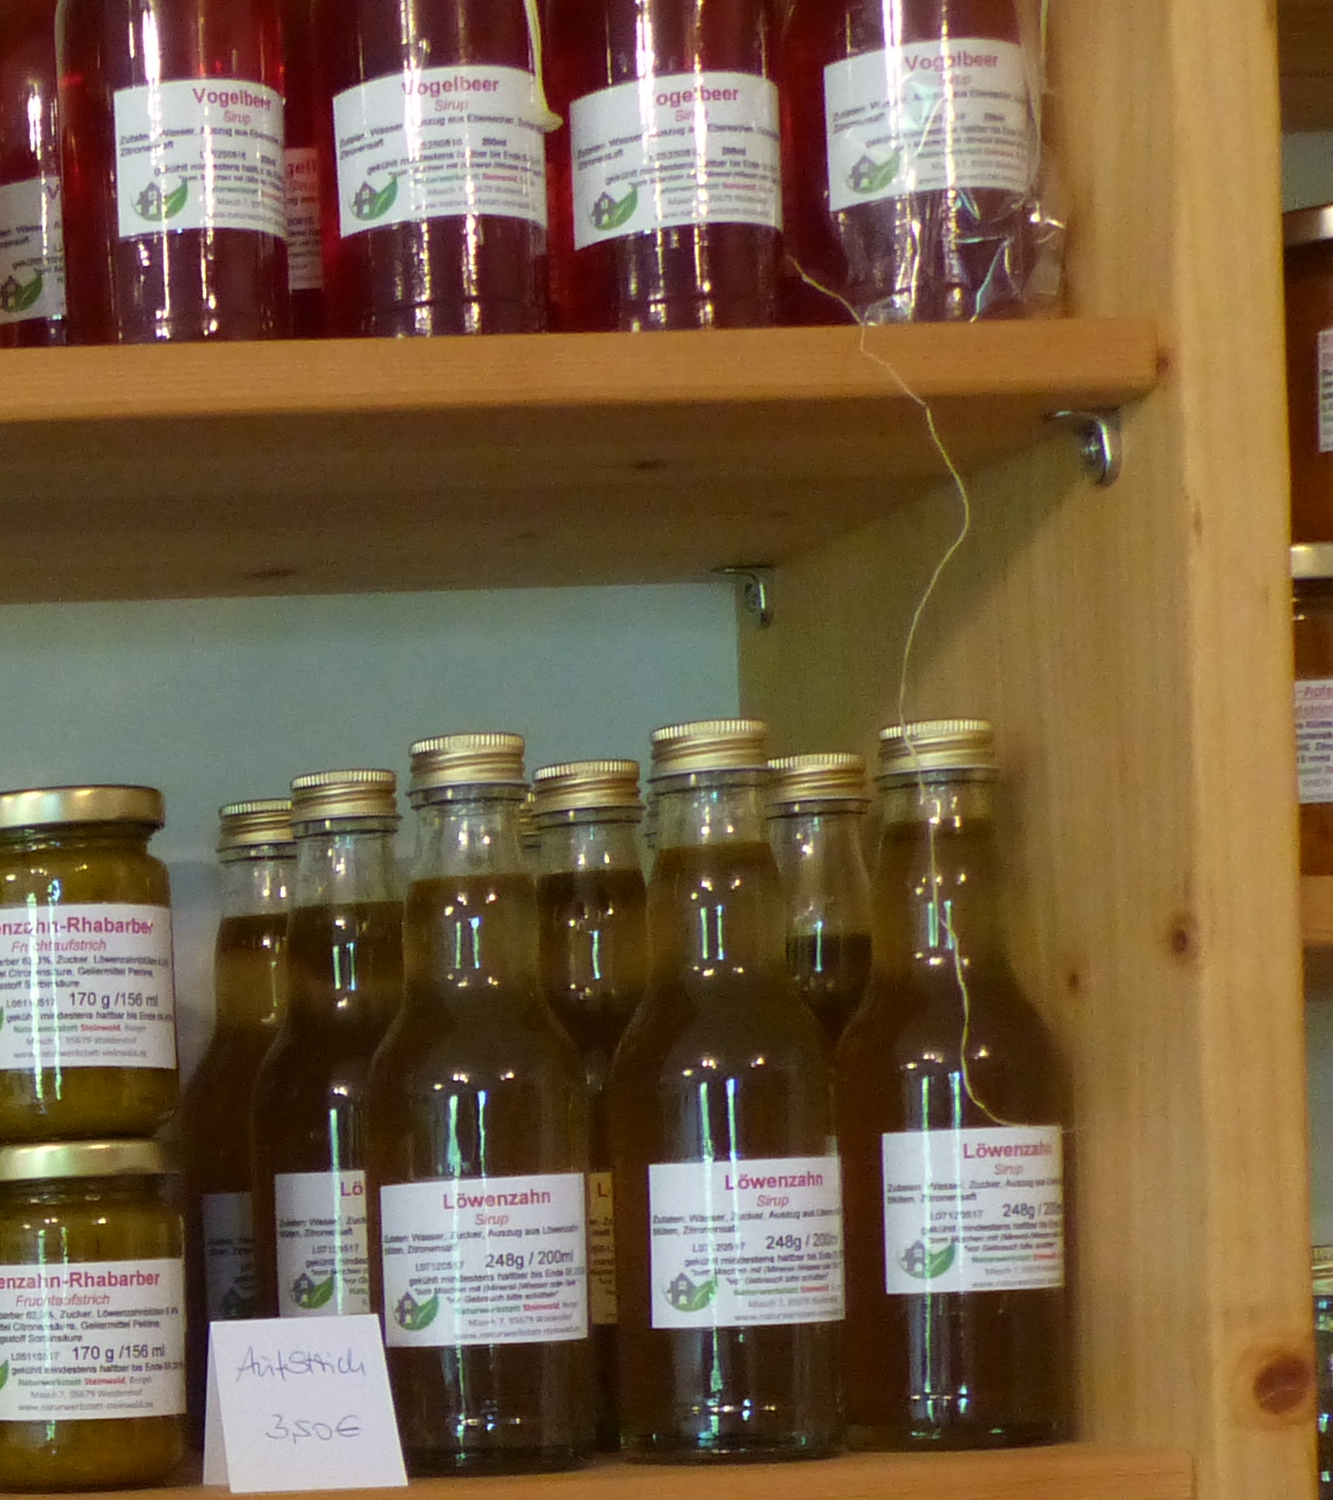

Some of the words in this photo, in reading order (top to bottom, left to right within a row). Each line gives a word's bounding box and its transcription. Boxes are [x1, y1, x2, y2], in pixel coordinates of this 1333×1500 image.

[193, 88, 271, 112] Vogelbeer
[223, 110, 252, 125] Sirup
[70, 992, 97, 1006] 170
[102, 994, 109, 1009] g
[994, 1163, 1023, 1176] Sirup
[725, 1171, 823, 1190] Löwenzahn
[443, 1189, 551, 1210] Löwenzahn
[757, 1194, 789, 1209] Sirup
[1002, 1203, 1035, 1219] 248g
[765, 1234, 802, 1251] 248g
[485, 1253, 524, 1270] 248g
[538, 1250, 574, 1265] 200ml
[72, 1346, 100, 1360] 170
[105, 1348, 114, 1362] g
